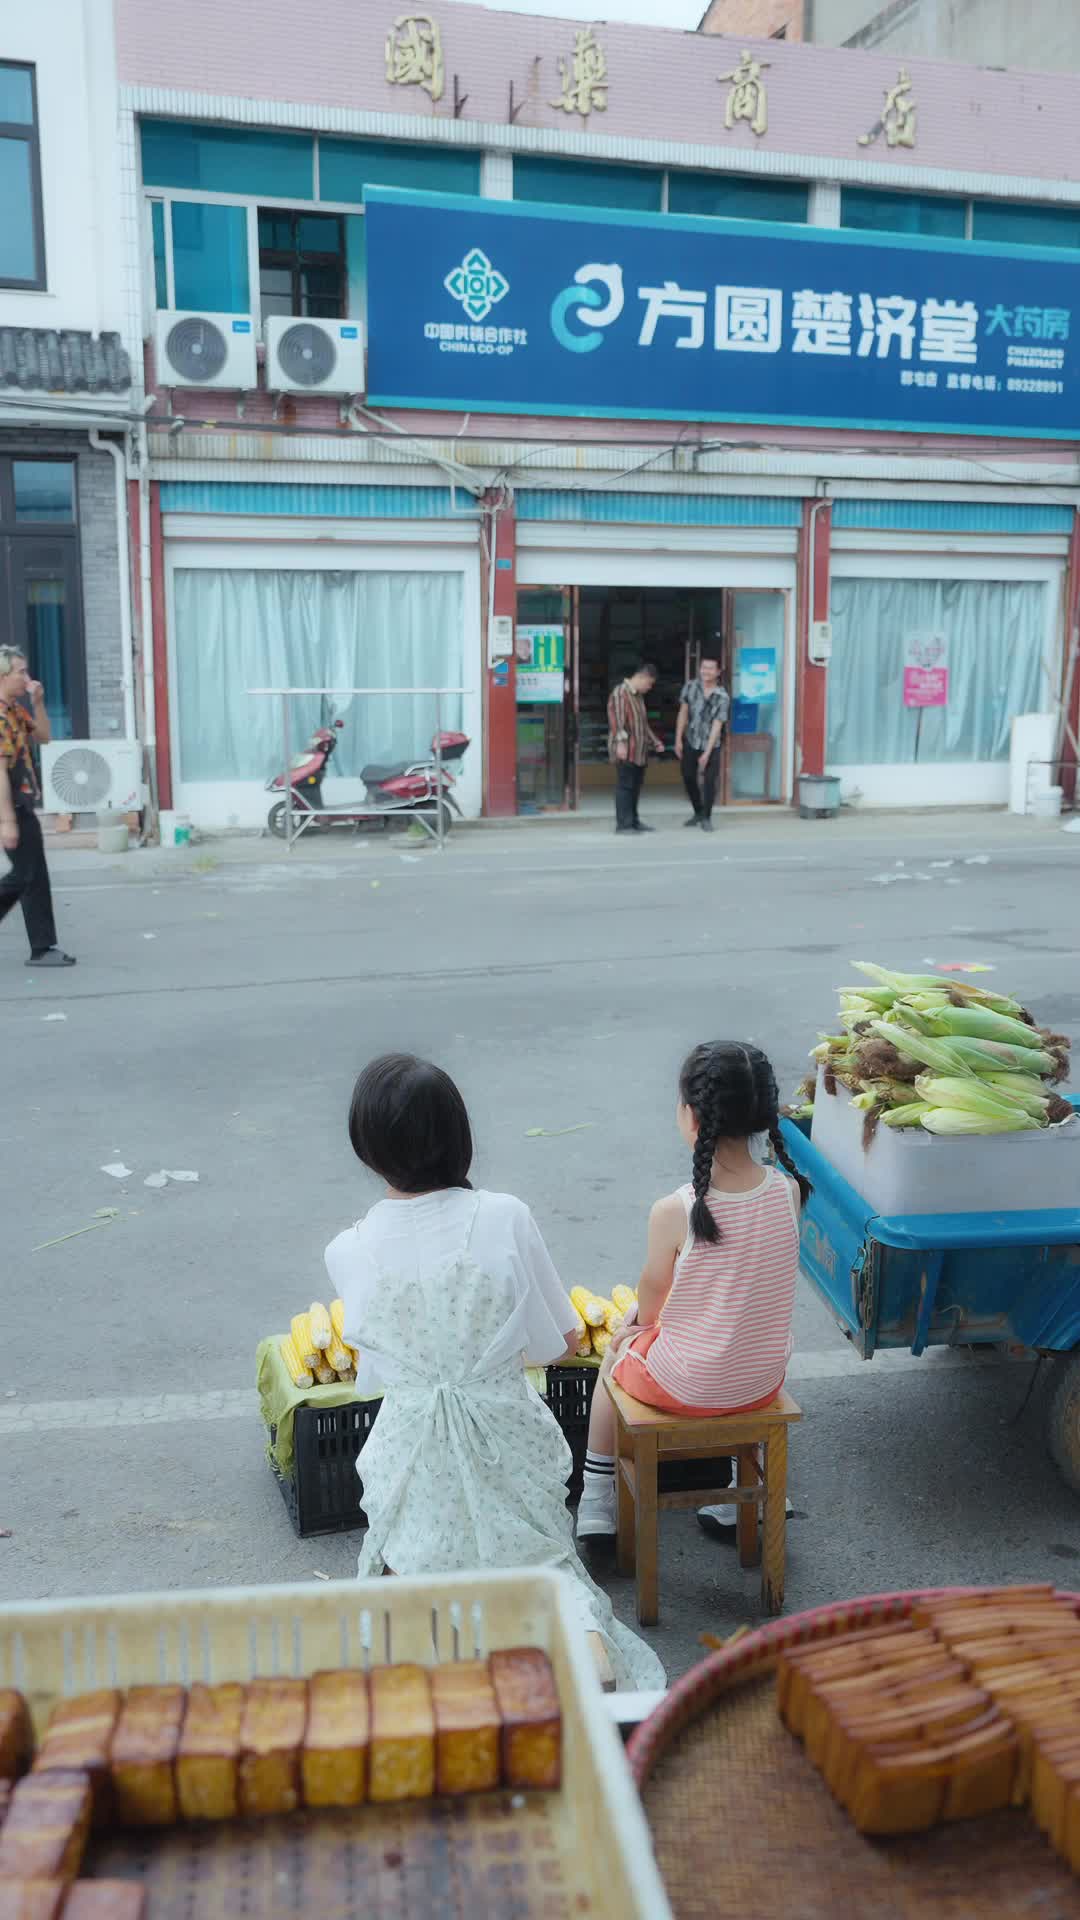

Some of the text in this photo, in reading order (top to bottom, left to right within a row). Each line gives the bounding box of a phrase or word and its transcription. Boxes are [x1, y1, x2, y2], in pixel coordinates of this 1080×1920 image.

[637, 281, 1070, 364] 方圆楚济堂 大药房
[440, 342, 475, 353] CHINA
